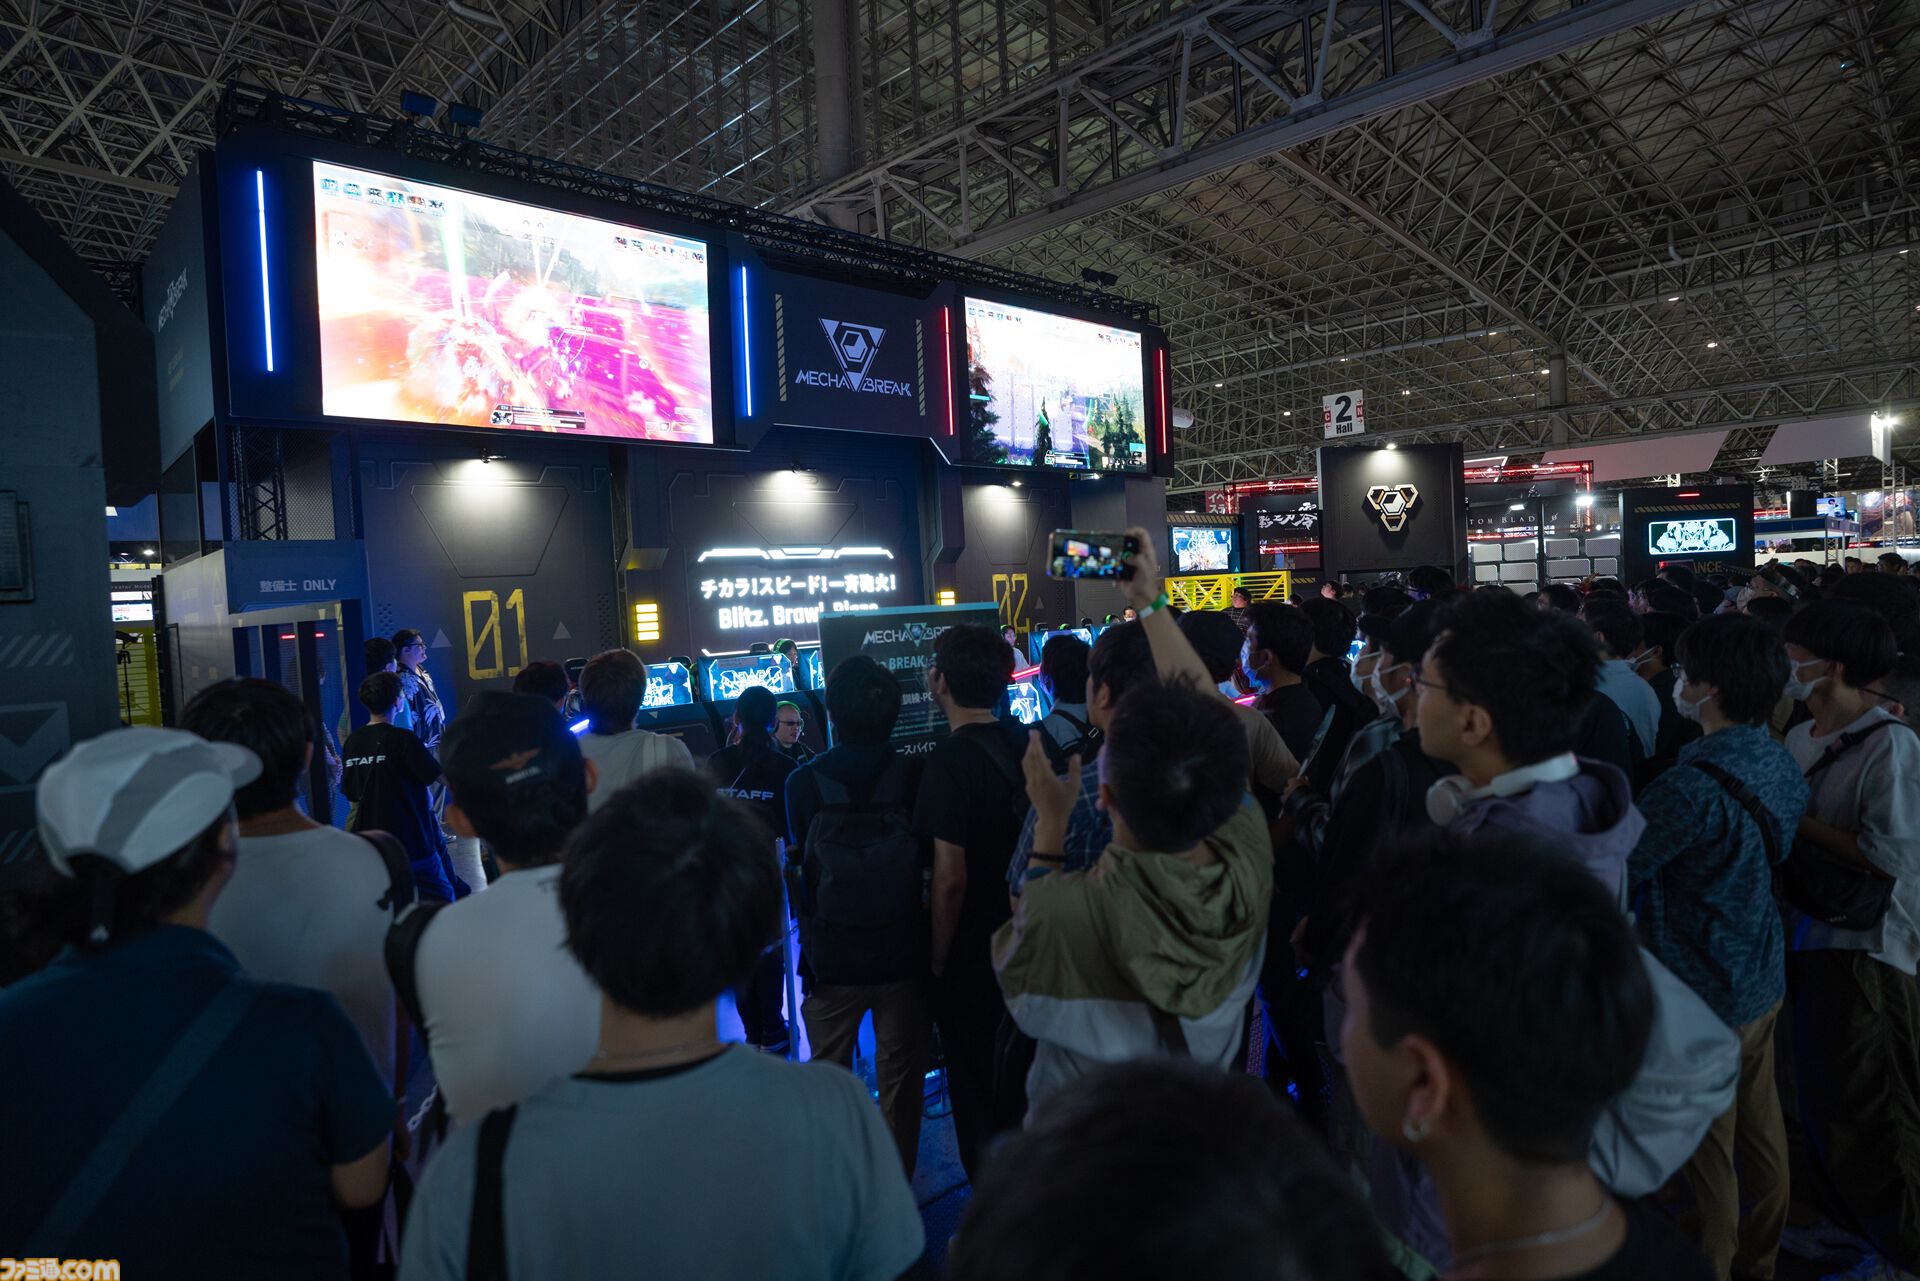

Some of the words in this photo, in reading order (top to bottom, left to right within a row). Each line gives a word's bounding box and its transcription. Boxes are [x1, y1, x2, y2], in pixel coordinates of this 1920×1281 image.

[795, 369, 851, 390] MECHA
[862, 377, 912, 397] BREAK
[1335, 395, 1352, 424] 2
[1336, 422, 1353, 434] Hall
[1501, 515, 1536, 523] BLAD
[260, 580, 297, 592] 整備士
[303, 579, 336, 591] ONLY
[718, 606, 769, 630] Blitz.
[463, 588, 529, 680] 01
[861, 629, 913, 650] MECHA
[889, 655, 925, 670] BREAK
[345, 755, 386, 768] STAFF
